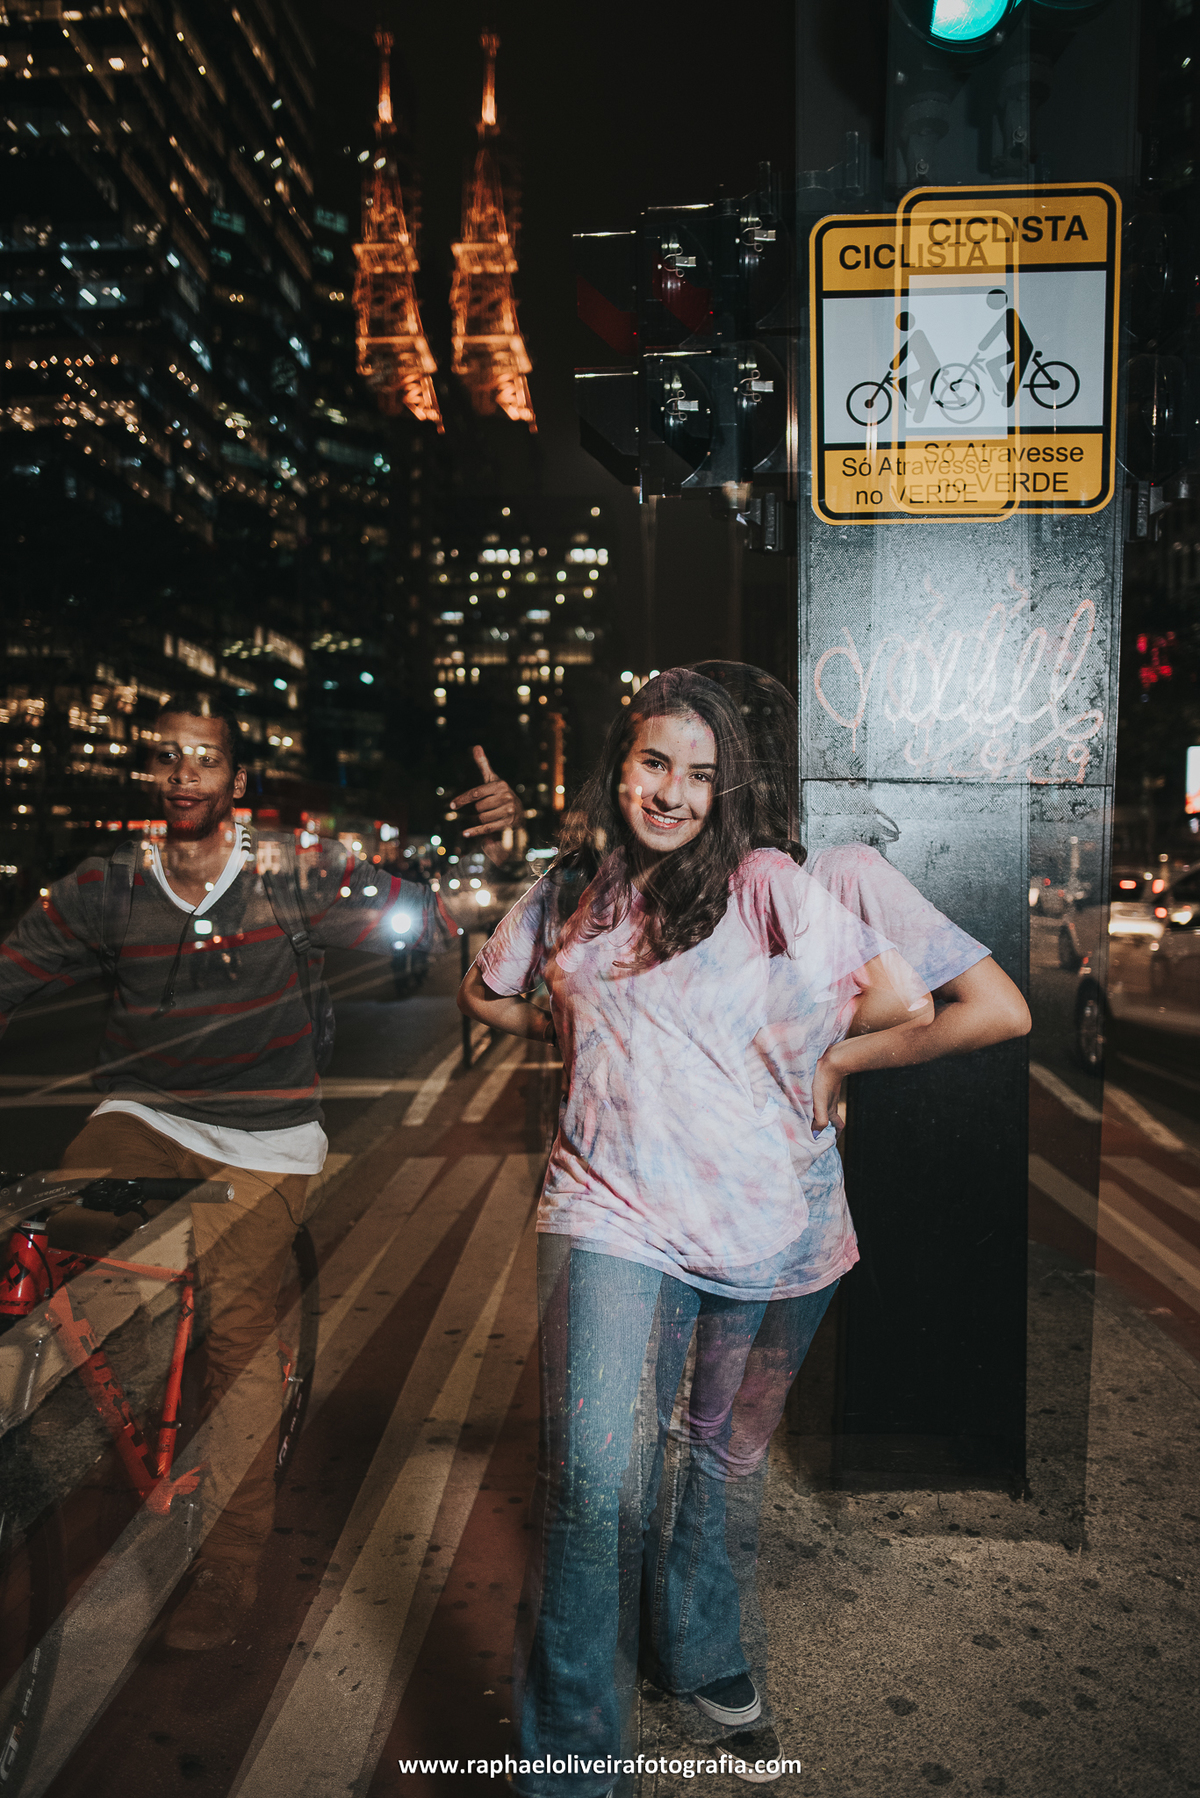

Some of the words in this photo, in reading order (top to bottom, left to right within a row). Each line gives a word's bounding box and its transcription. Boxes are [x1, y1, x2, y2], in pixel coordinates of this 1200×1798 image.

[928, 215, 1089, 245] CICLISTA
[839, 242, 989, 270] CICLISTA
[963, 443, 1084, 463] Atravesse
[842, 456, 872, 477] Só
[878, 456, 991, 475] Atravesse
[975, 472, 1069, 493] VERDE
[856, 490, 883, 505] no
[890, 484, 978, 504] VERDE
